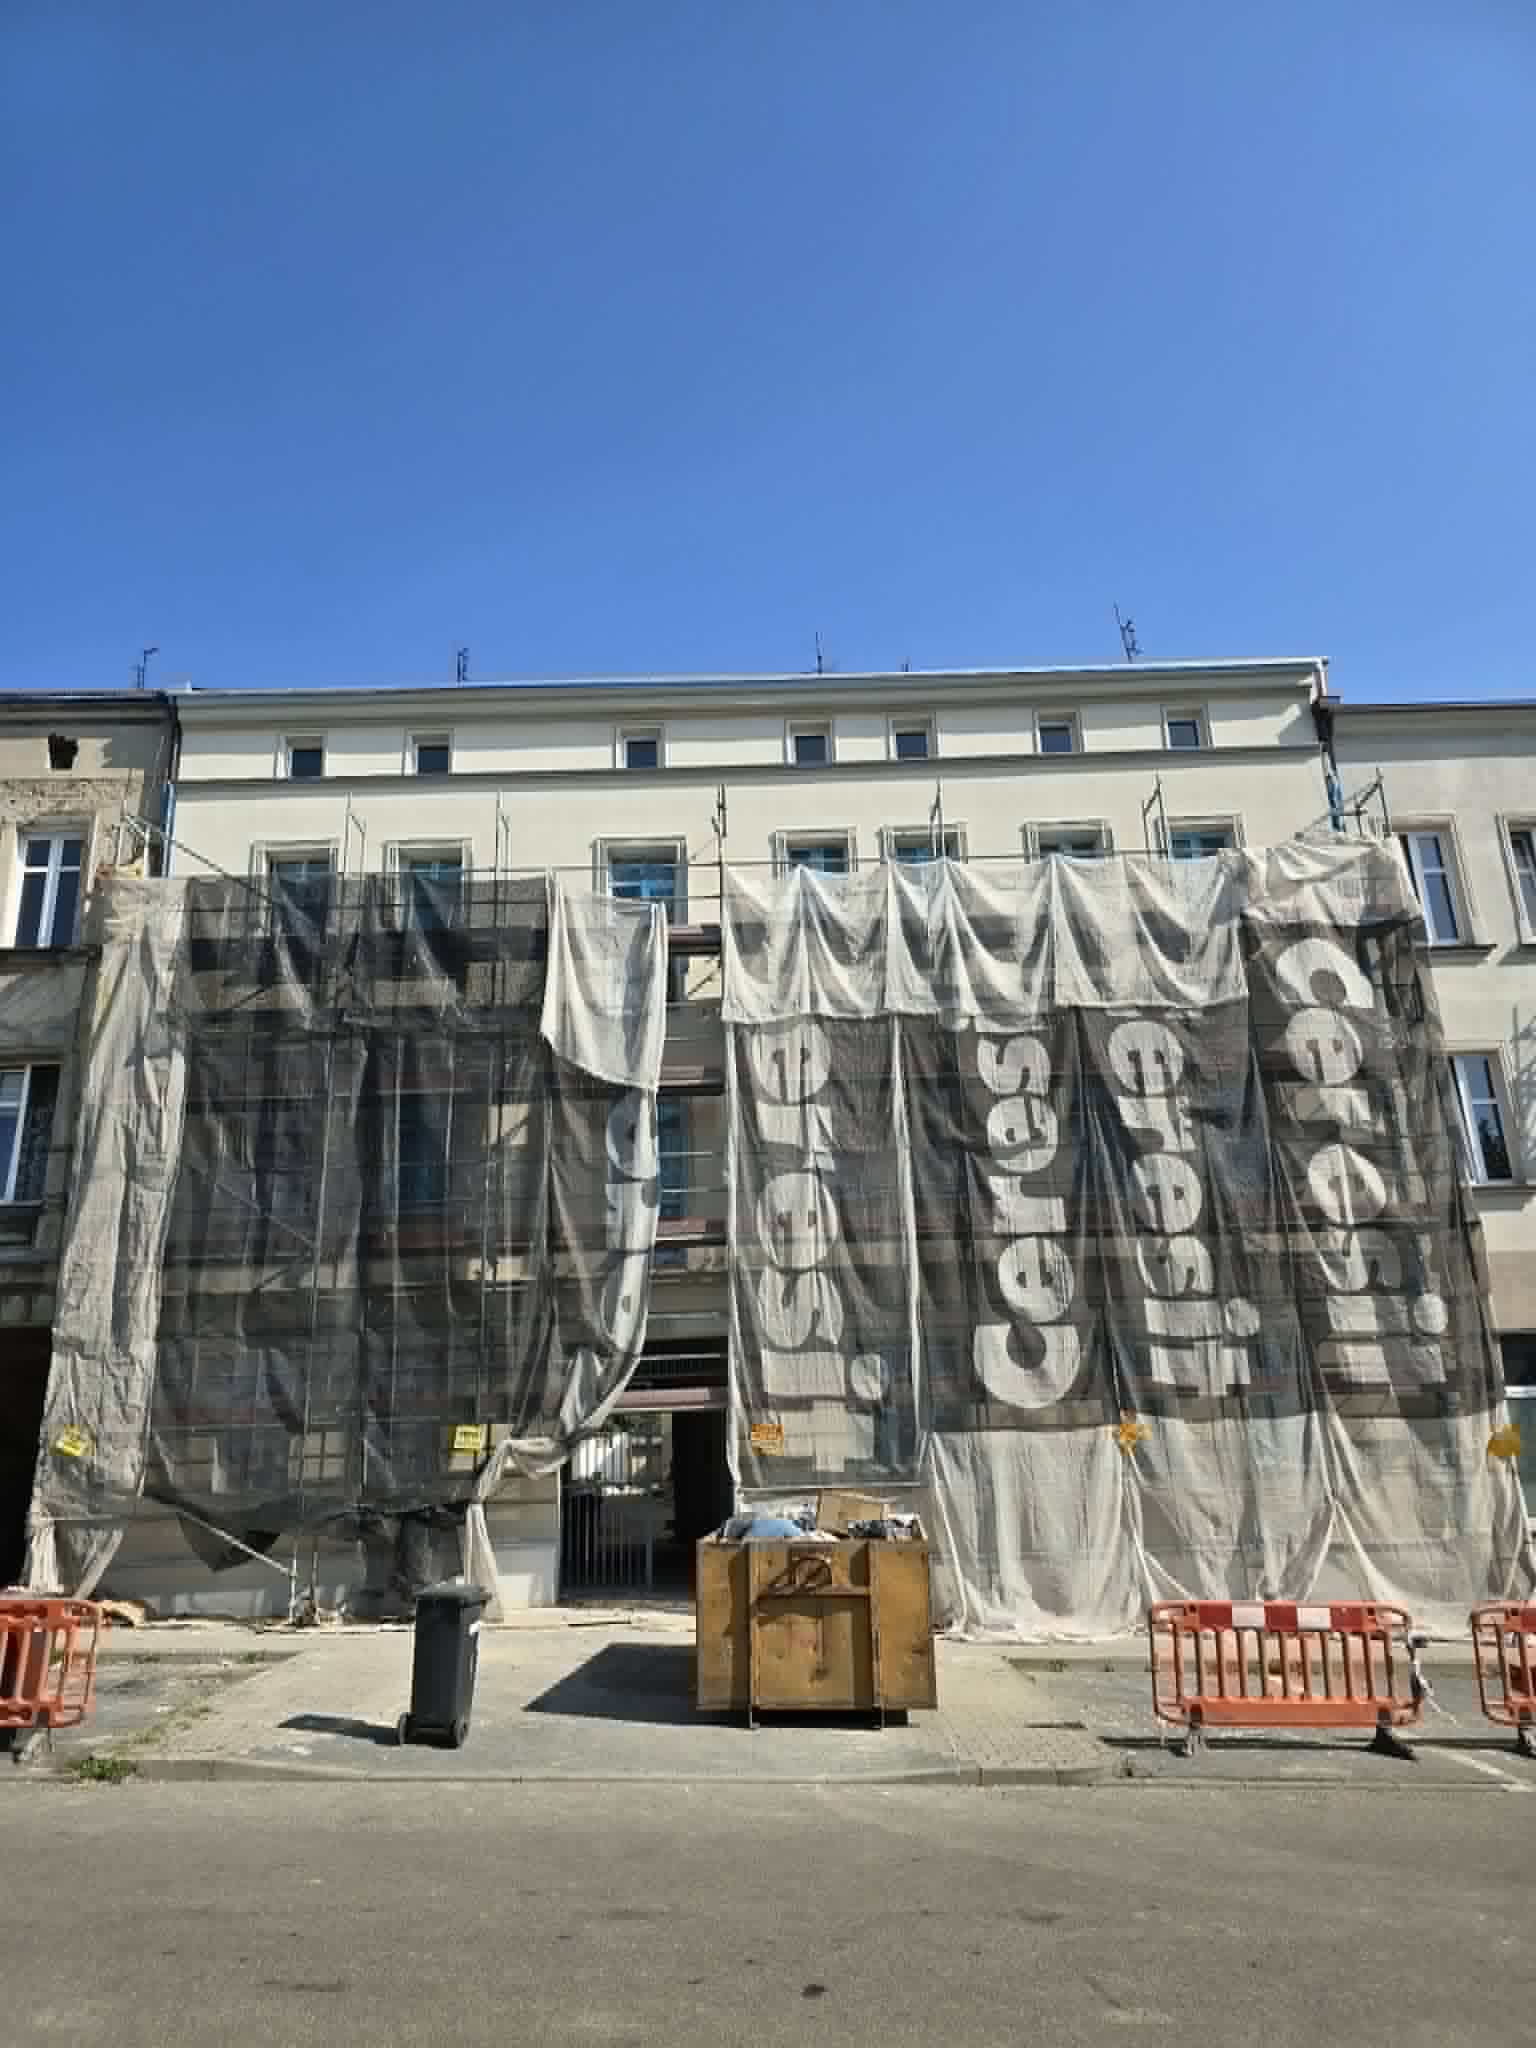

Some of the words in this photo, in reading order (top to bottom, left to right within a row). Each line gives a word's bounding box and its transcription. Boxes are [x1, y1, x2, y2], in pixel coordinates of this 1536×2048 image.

[752, 1020, 883, 1472] eresit
[972, 1016, 1081, 1409] Ceres
[1108, 1010, 1262, 1397] eresit
[1276, 937, 1449, 1387] Ceresit
